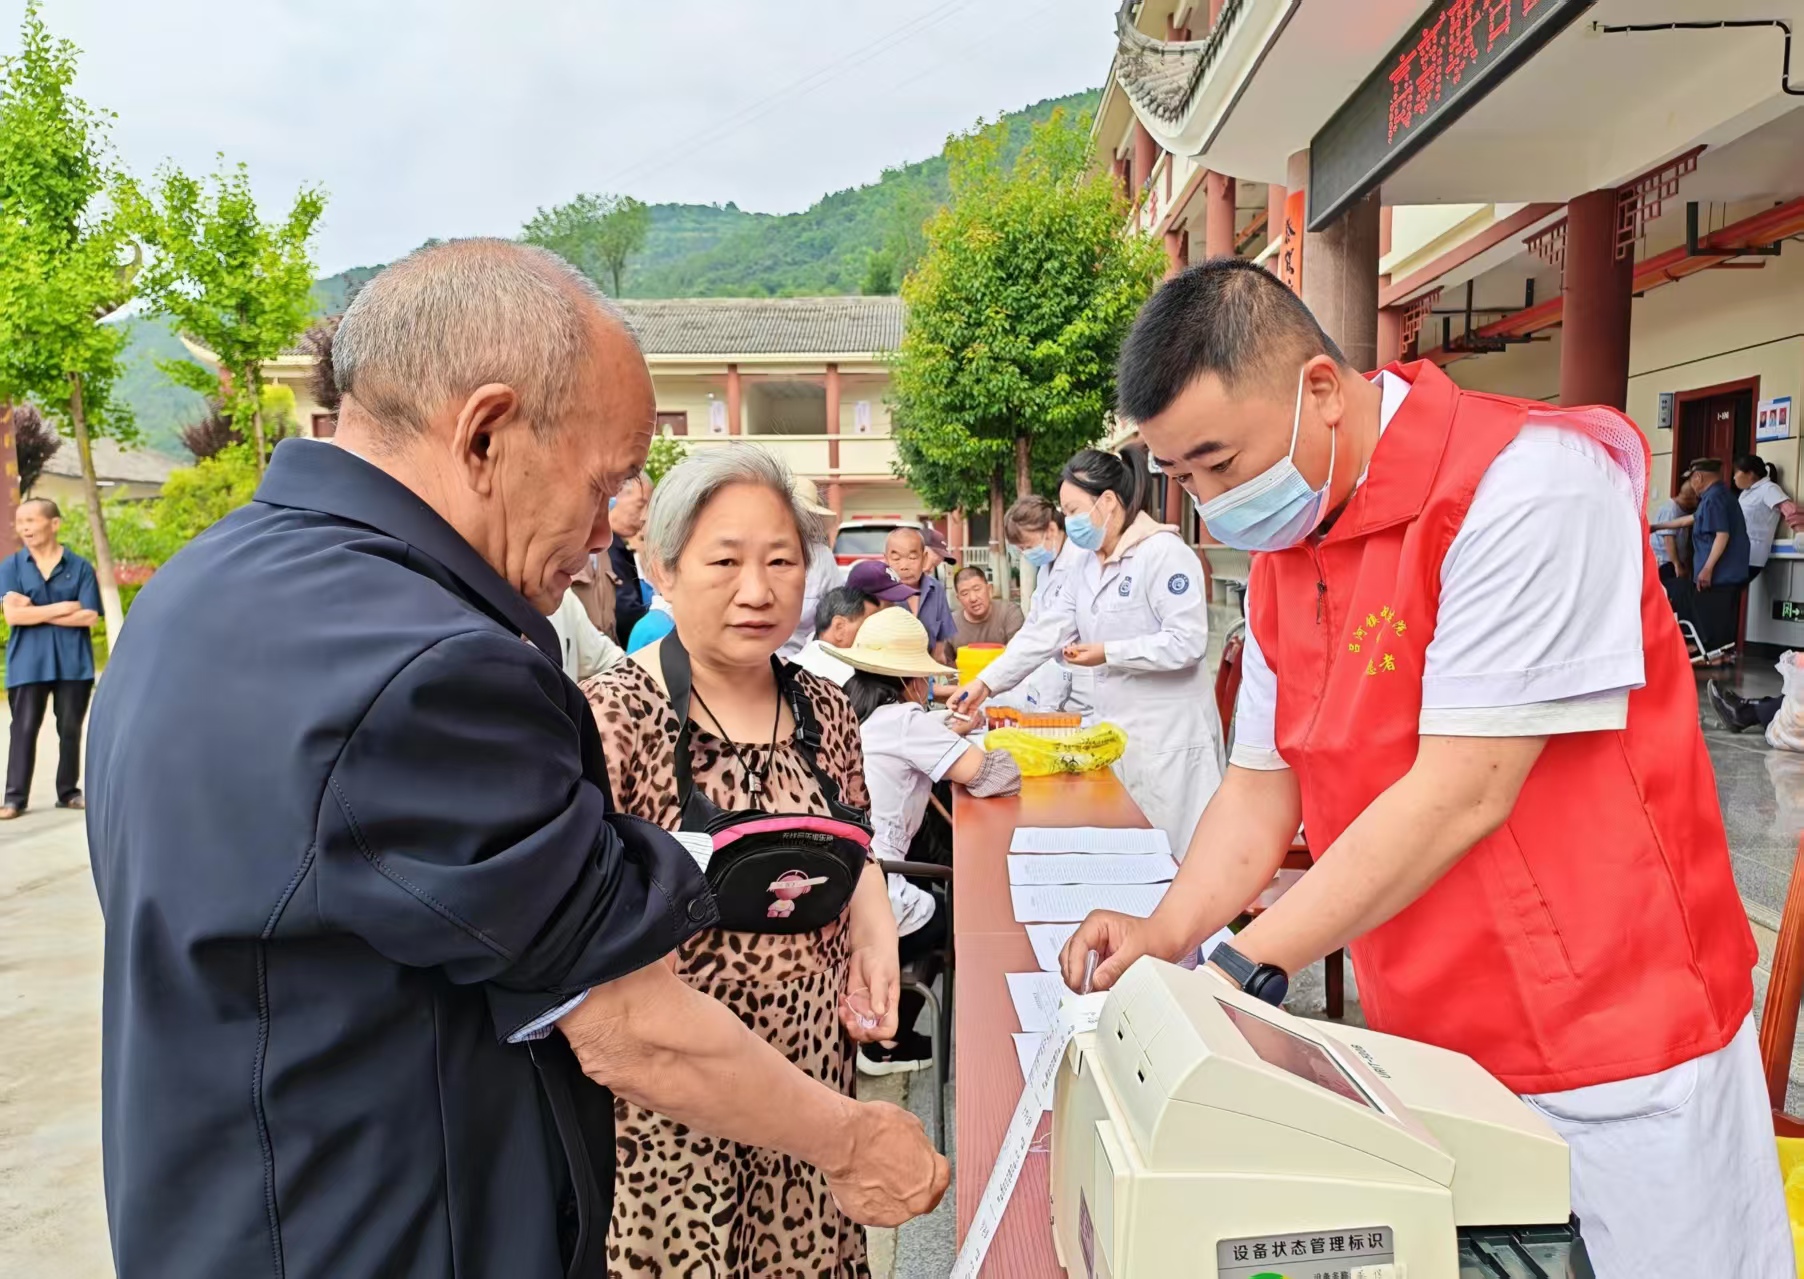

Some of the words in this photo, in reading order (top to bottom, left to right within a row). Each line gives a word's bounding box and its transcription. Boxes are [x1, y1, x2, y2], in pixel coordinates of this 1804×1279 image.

[1233, 1233, 1384, 1261] 设备状态管理标识
